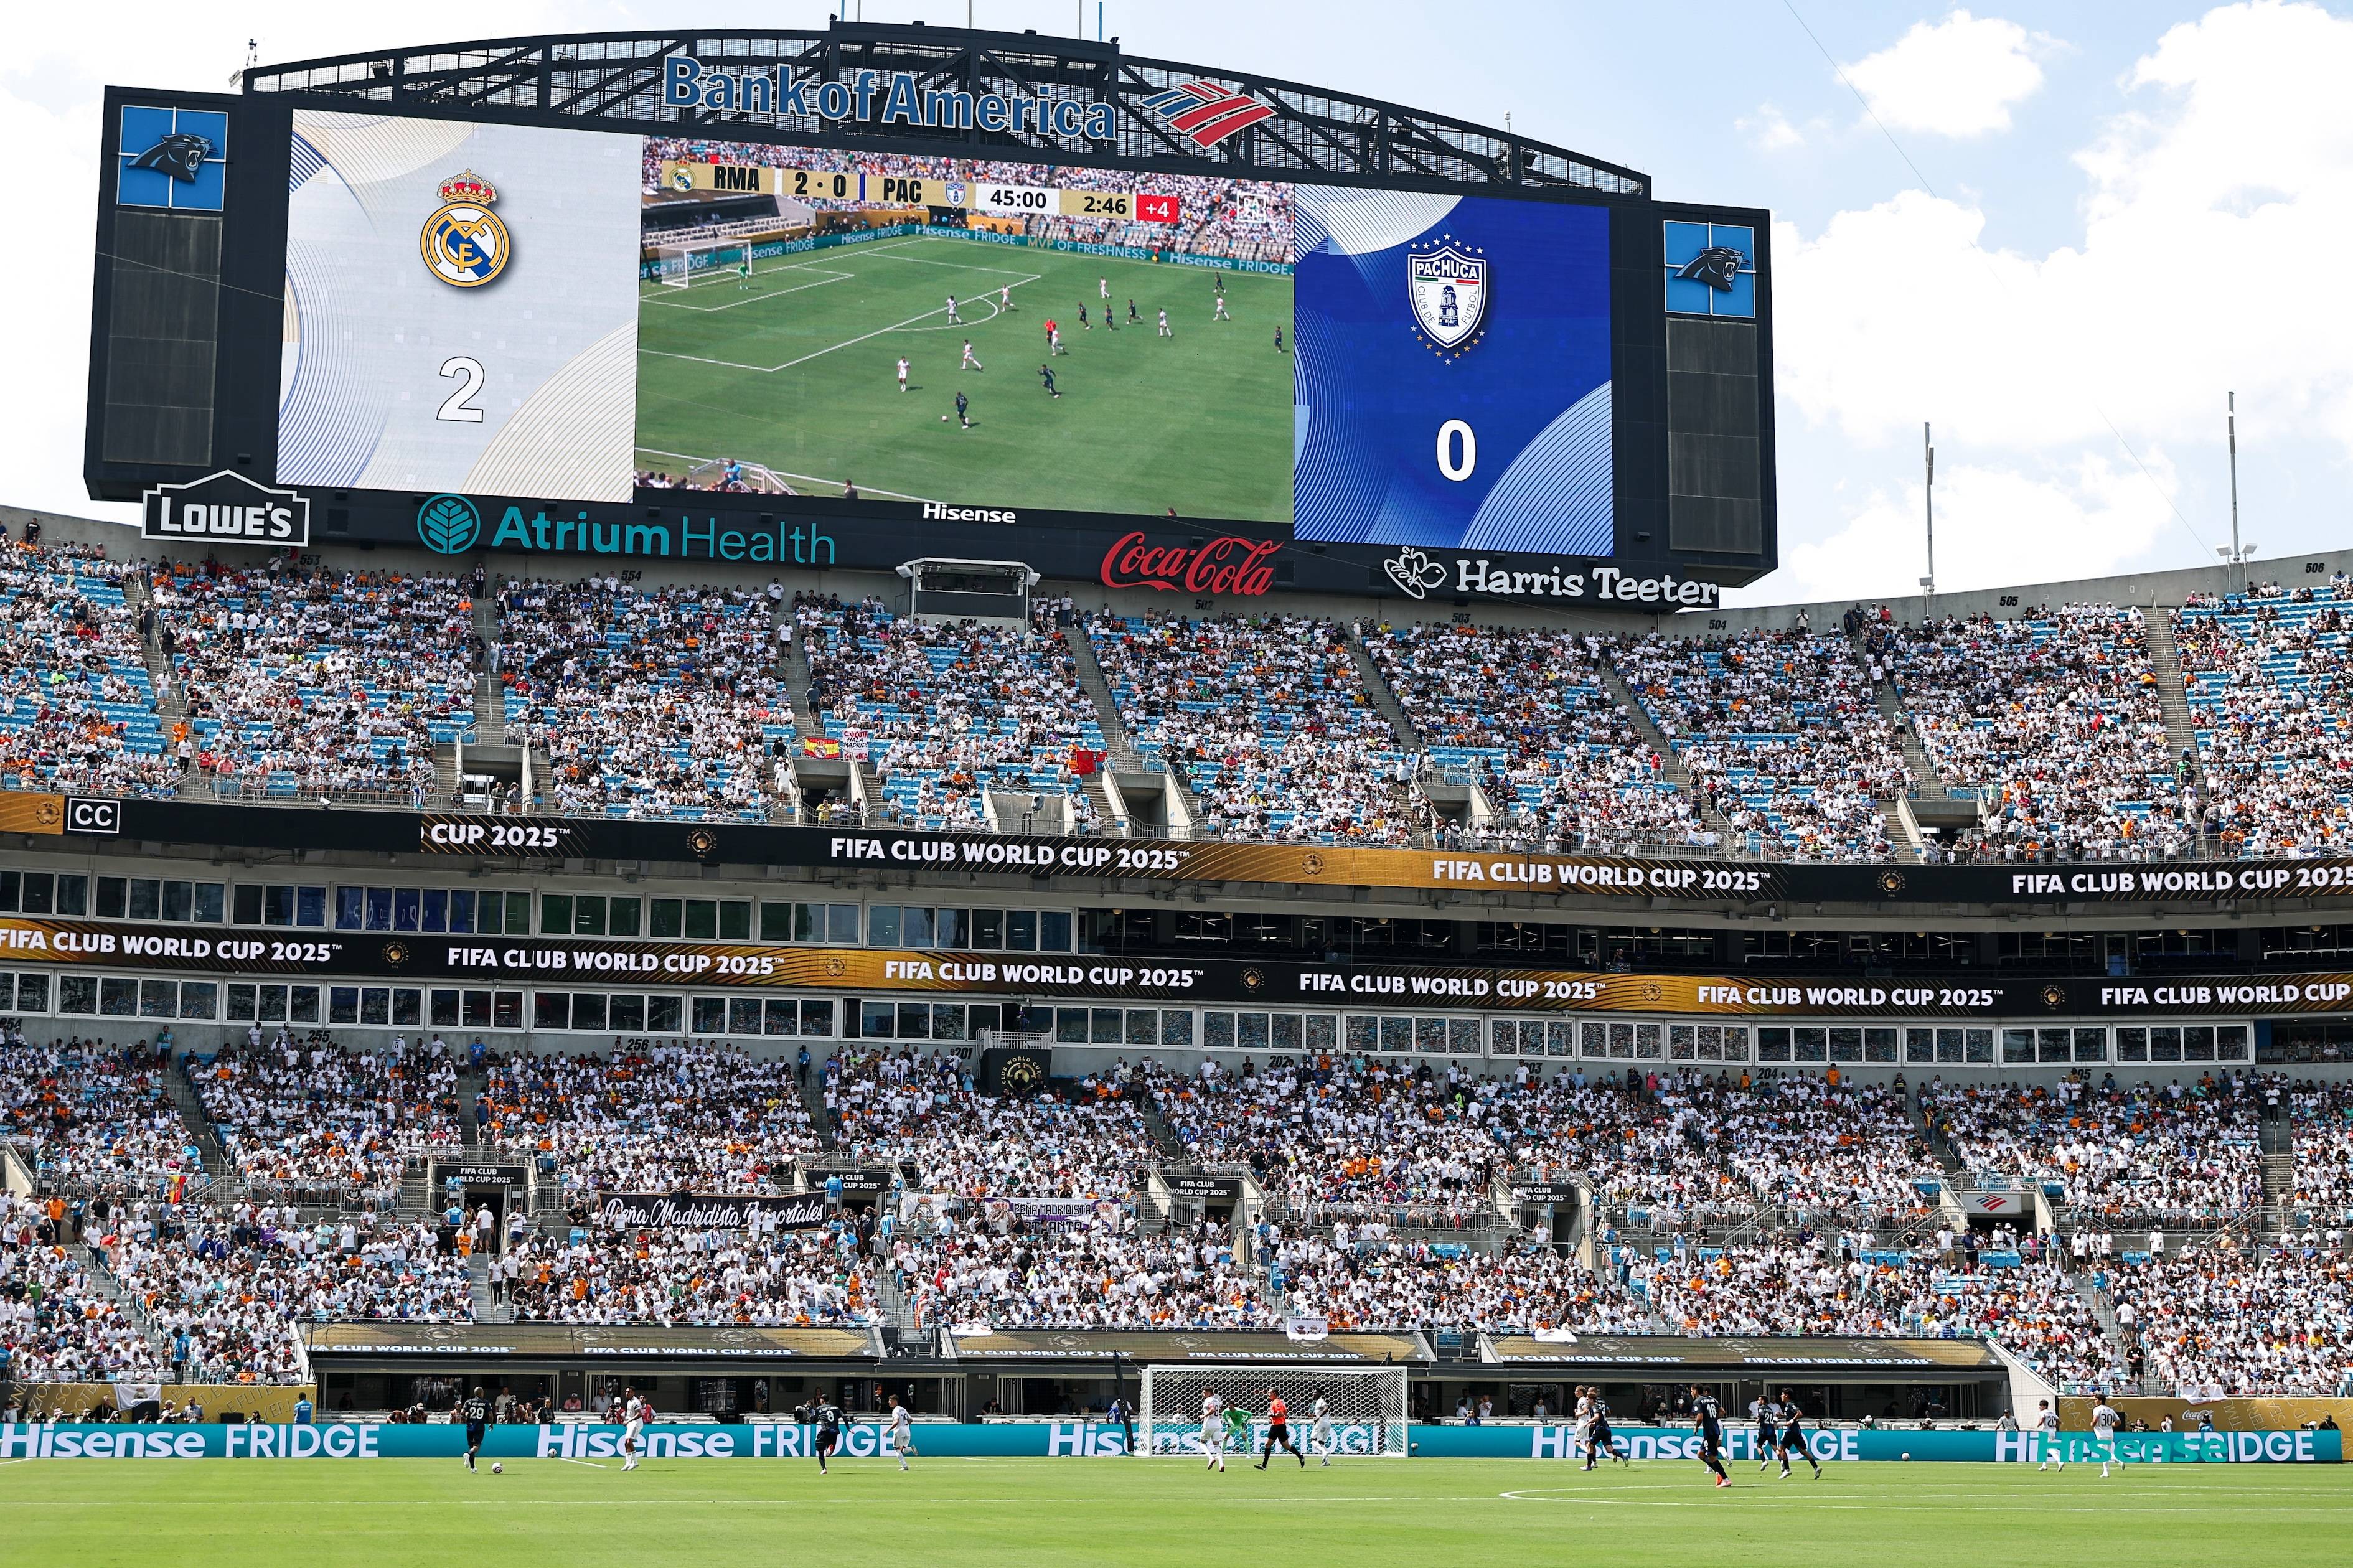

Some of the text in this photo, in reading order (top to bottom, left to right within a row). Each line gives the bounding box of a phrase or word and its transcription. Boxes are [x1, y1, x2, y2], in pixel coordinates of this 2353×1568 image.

[664, 54, 1118, 142] Bank of America
[714, 166, 1170, 218] RMA 2 0 PAC 45:00 2:46 +4
[842, 225, 903, 245] Hisense FRIDGE
[916, 225, 970, 240] Hisense
[1028, 237, 1053, 249] MVP
[1058, 240, 1074, 250] OF
[1077, 242, 1147, 260] FRESHNESS
[1170, 253, 1233, 270] Hisense
[1416, 259, 1478, 279] PACHUCA
[1417, 286, 1477, 324] CLUB DE FUTBOL
[436, 356, 485, 423] 2
[1436, 418, 1477, 482] 0
[160, 495, 293, 540] LOWE'S
[923, 502, 1017, 524] Hisense
[491, 506, 837, 565] Atrium Health
[299, 554, 322, 566] 553
[1100, 531, 1285, 597] Coca-Cola
[2305, 562, 2325, 574] 506
[621, 570, 642, 581] 554
[1455, 558, 1721, 606] Harris Teeter
[1195, 599, 1214, 610] 502
[1999, 596, 2019, 607] 505
[1451, 613, 1471, 624] 503
[1709, 619, 1727, 630] 504
[74, 804, 113, 827] CC
[431, 824, 485, 844] CUP
[832, 838, 885, 858] FIFA
[891, 840, 956, 861] CLUB
[962, 843, 1054, 865] WORLD
[1061, 847, 1111, 866] CUP
[1434, 861, 1485, 880] FIFA
[1491, 863, 1552, 883] CLUB
[1558, 865, 1645, 886] WORLD
[1650, 868, 1696, 888] CUP
[2013, 866, 2353, 893] FIFA CLUB WORLD CUP 2025
[0, 929, 47, 950] FIFA
[54, 932, 116, 952] CLUB
[123, 936, 210, 957] WORLD
[217, 941, 265, 959] CUP
[448, 947, 499, 966] FIFA
[504, 950, 567, 969] CLUB
[573, 952, 659, 971] WORLD
[664, 955, 711, 972] CUP
[886, 961, 934, 979] FIFA
[939, 963, 996, 981] CLUB
[1002, 965, 1084, 984] WORLD
[1089, 967, 1134, 985] CUP
[1300, 974, 1346, 992] FIFA
[1351, 975, 1406, 993] CLUB
[1411, 977, 1489, 996] WORLD
[1496, 980, 1539, 997] CUP
[1698, 985, 1740, 1003] FIFA
[1745, 987, 1801, 1005] CLUB
[1807, 988, 1886, 1005] WORLD
[1892, 988, 1935, 1006] CUP
[2102, 983, 2351, 1005] FIFA CLUB WORLD CUP
[307, 1030, 331, 1043] 255
[625, 1038, 650, 1051] 256
[956, 1047, 973, 1059] 201
[1006, 1056, 1031, 1066] WORLD
[1268, 1055, 1290, 1068] 202
[1756, 1068, 1778, 1079] 204
[650, 1199, 742, 1228] Madridista
[1040, 1204, 1092, 1215] MADRIDISTA
[469, 1407, 484, 1420] 29
[826, 1410, 834, 1422] 8
[1214, 1404, 1219, 1417] 8
[2101, 1414, 2113, 1426] 30
[1, 1424, 380, 1458] Hisense FRIDGE
[537, 1424, 735, 1458] Hisense
[1531, 1427, 1704, 1459] Hiense
